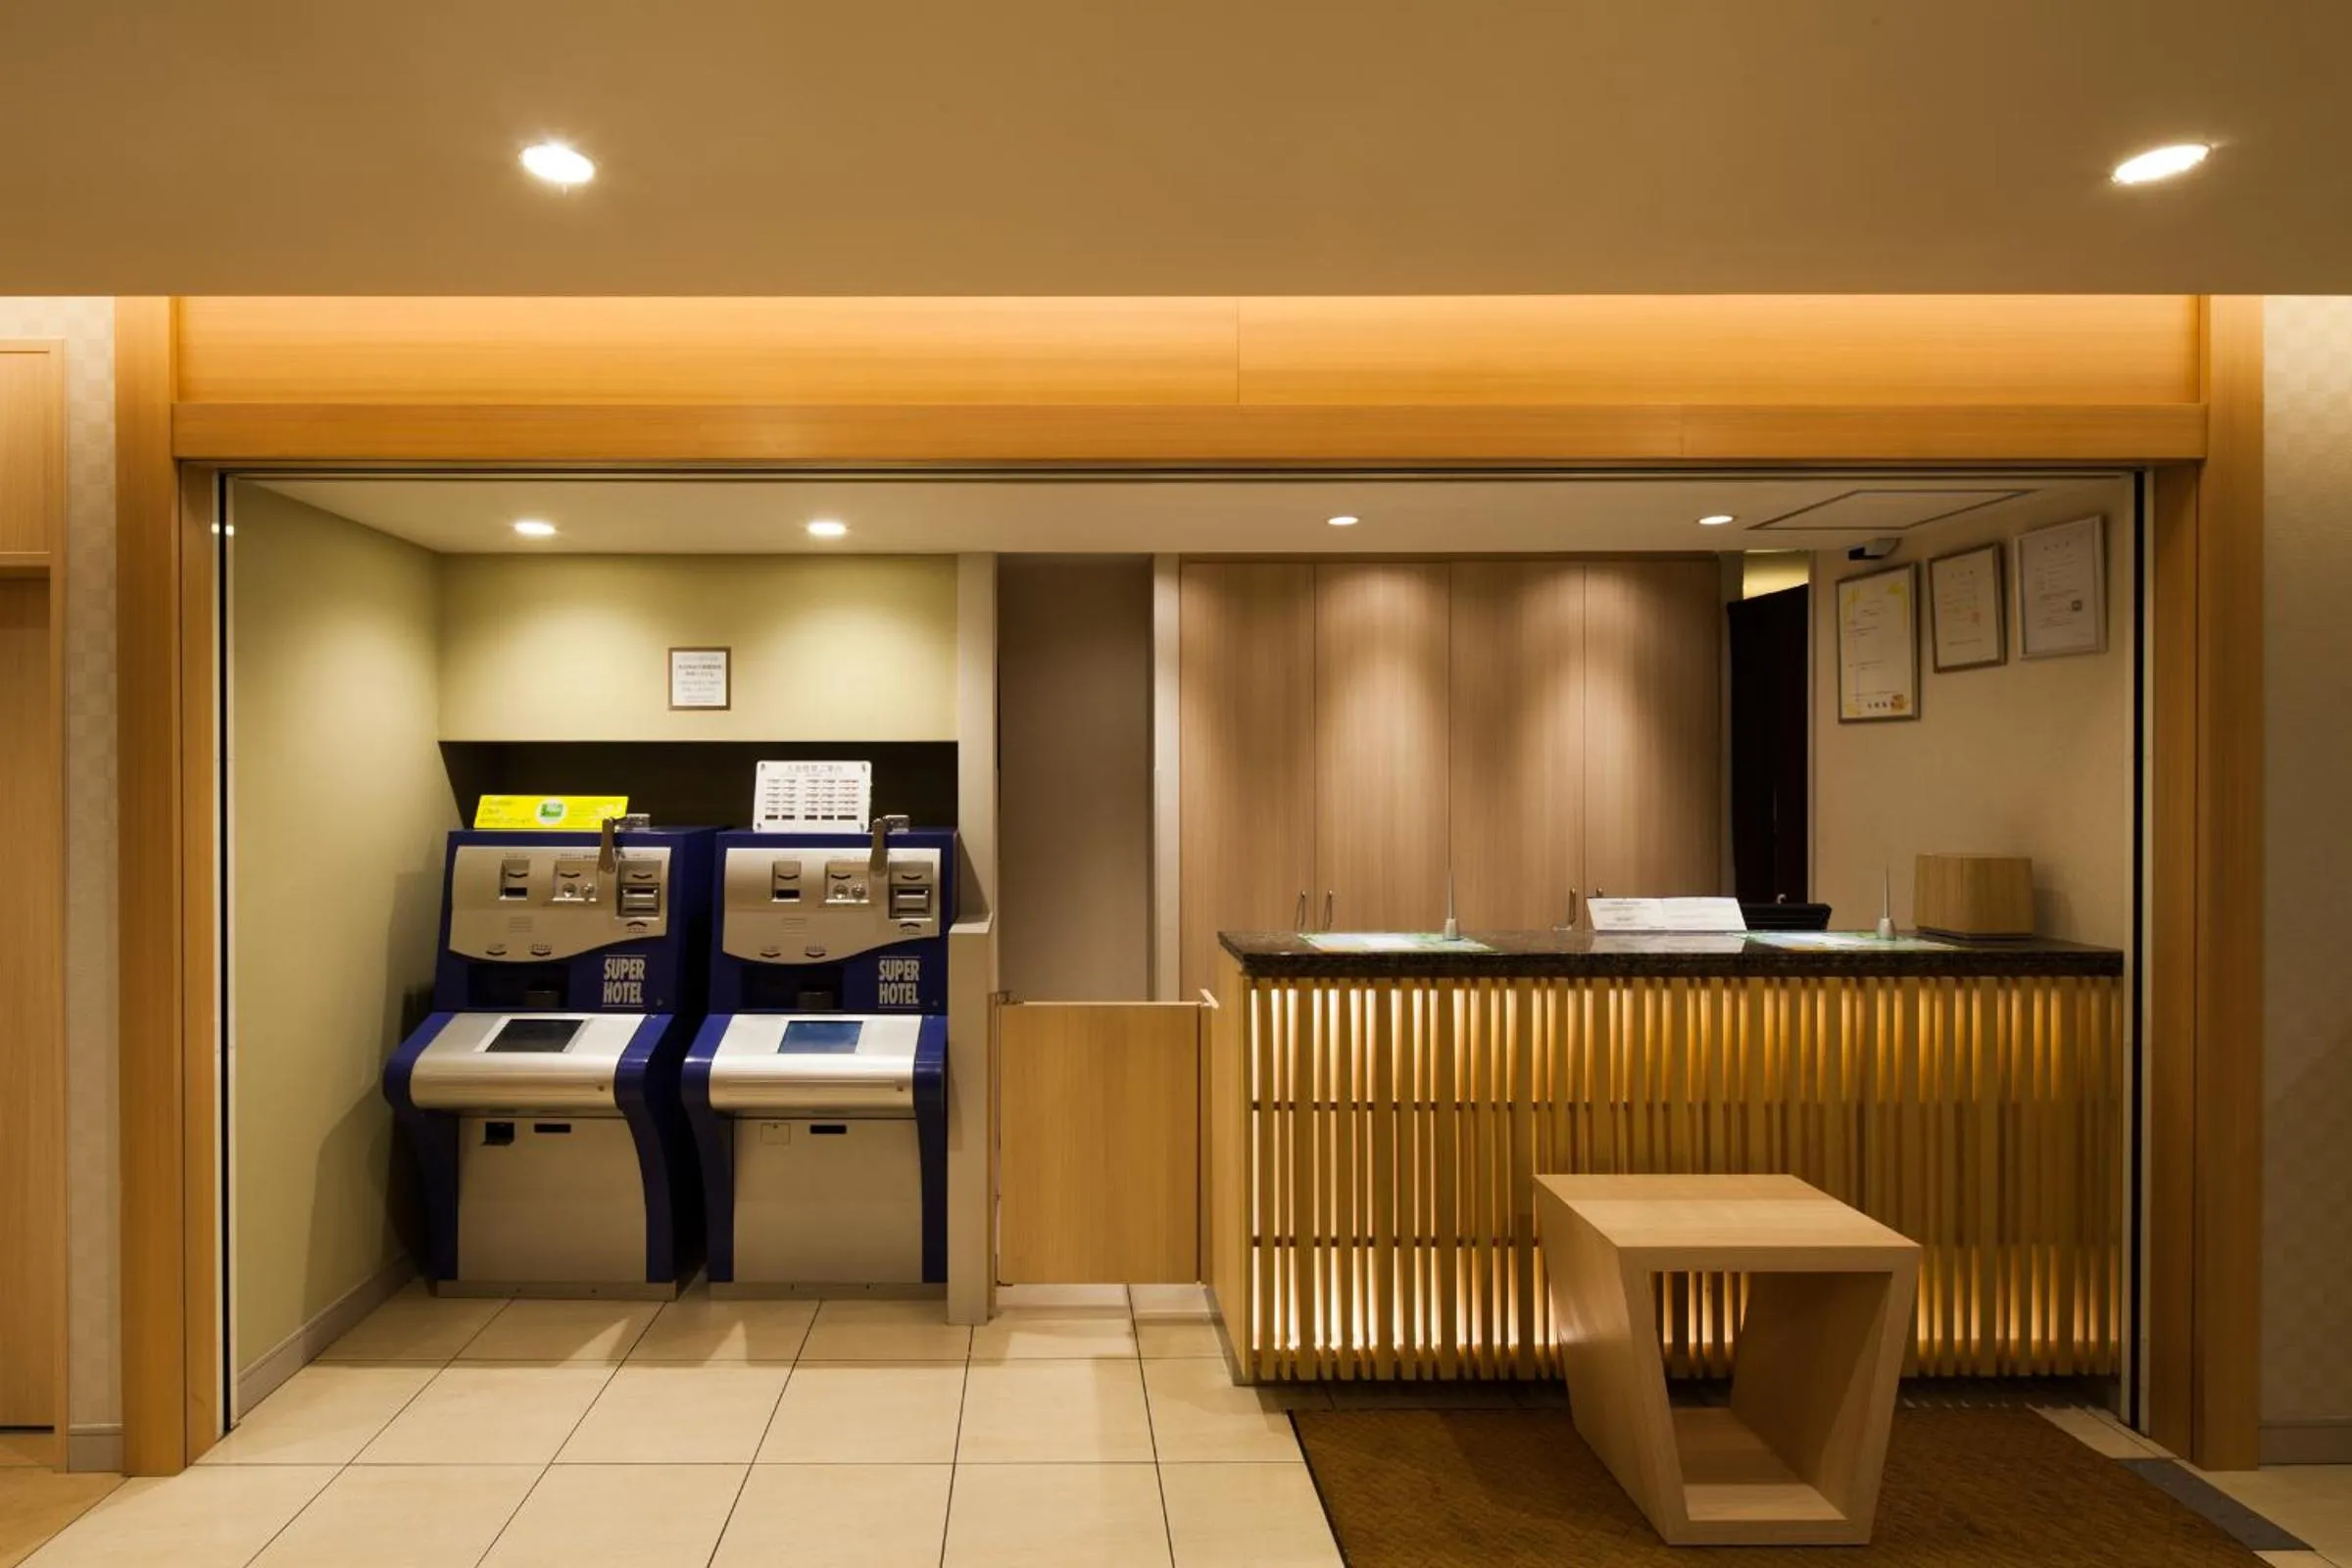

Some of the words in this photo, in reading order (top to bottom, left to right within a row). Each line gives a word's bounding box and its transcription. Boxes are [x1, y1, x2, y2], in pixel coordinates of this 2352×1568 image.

[604, 958, 645, 980] SUPER
[878, 959, 919, 981] SUPER
[603, 981, 643, 1004] HOTEL
[879, 982, 919, 1004] HOTEL
